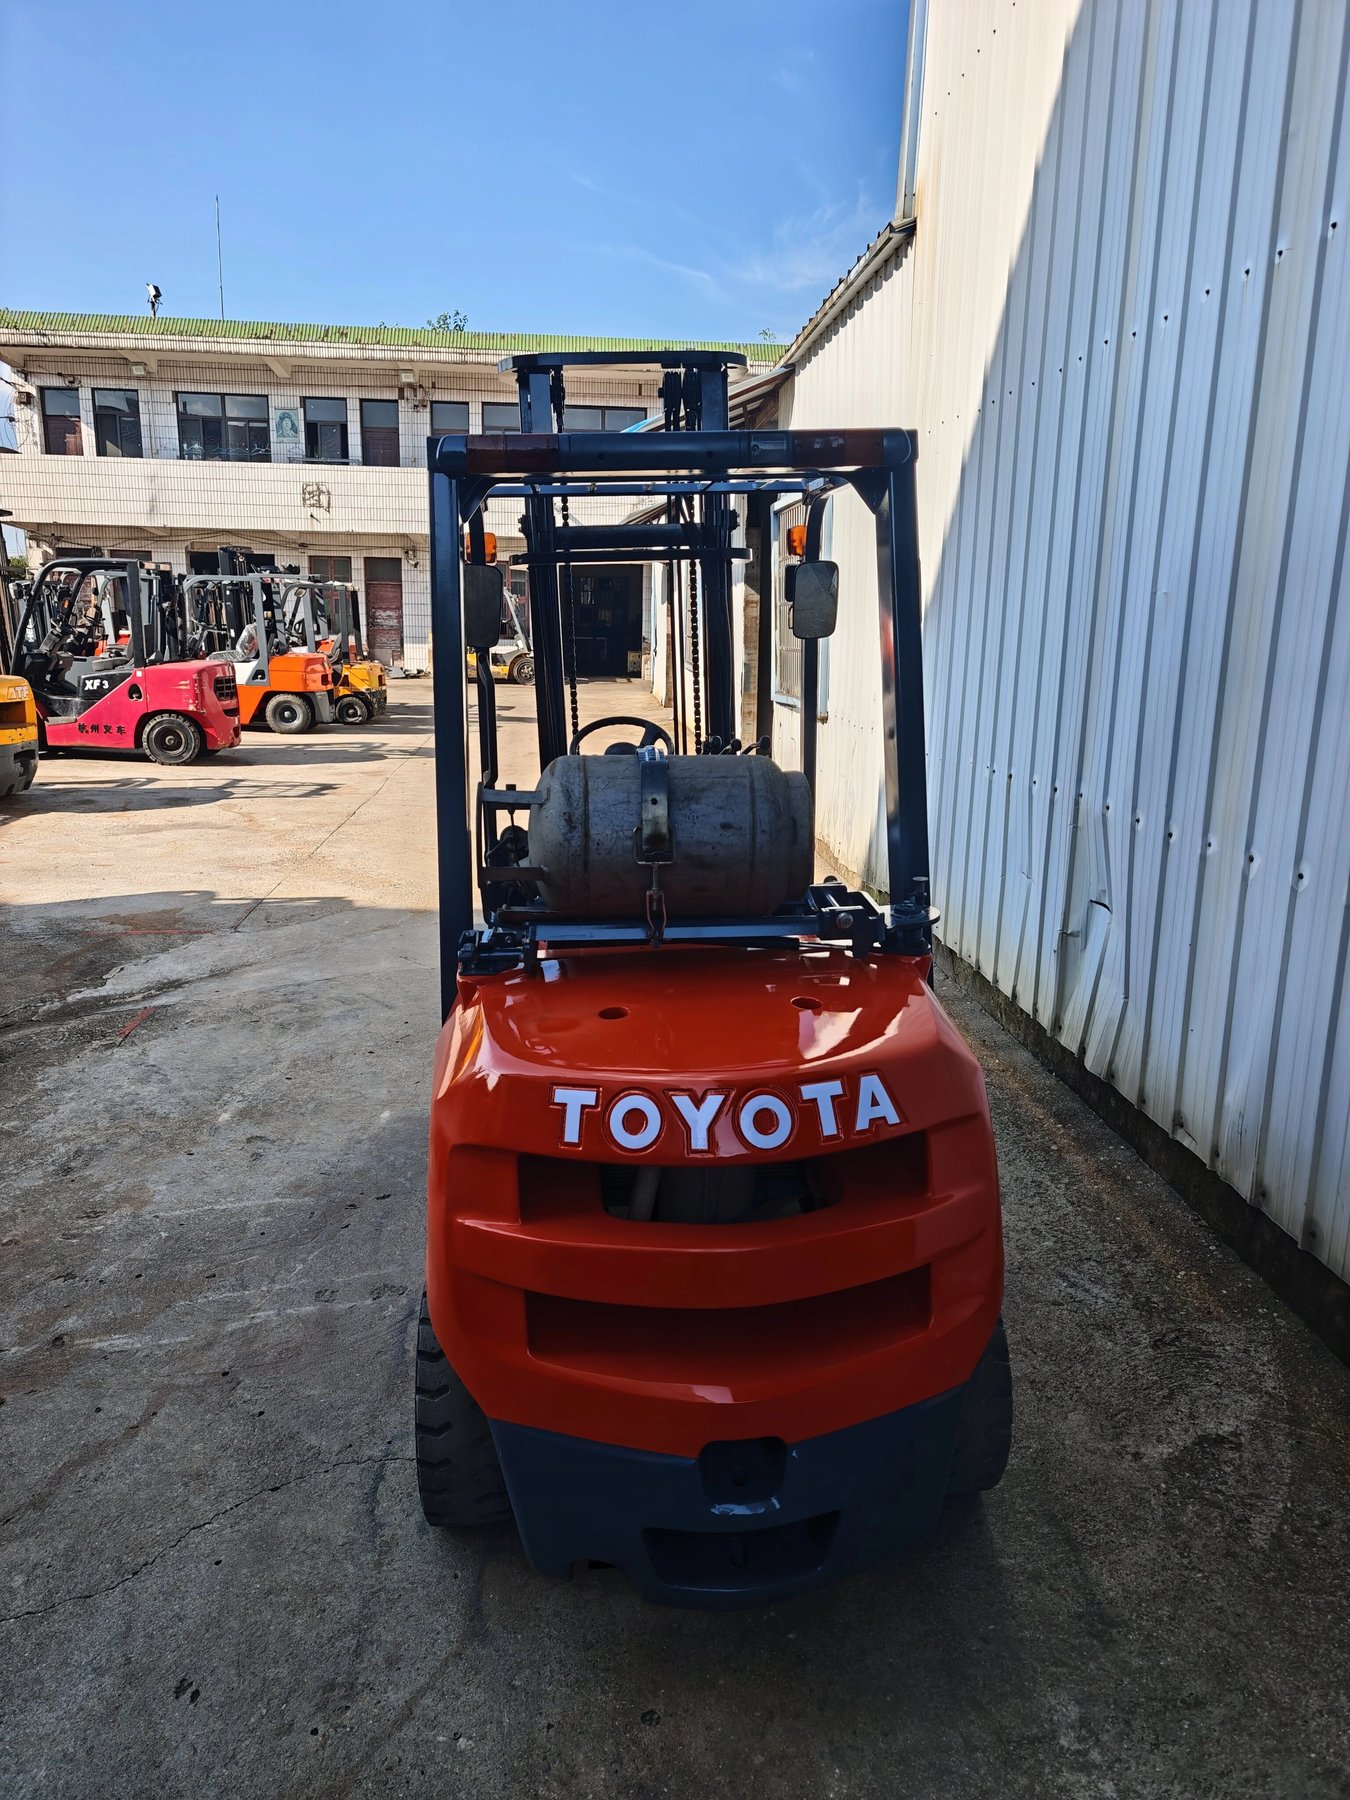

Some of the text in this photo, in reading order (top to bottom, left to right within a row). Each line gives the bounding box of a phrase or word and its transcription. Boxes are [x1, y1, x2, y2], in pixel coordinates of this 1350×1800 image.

[84, 679, 109, 690] XF 3
[78, 722, 126, 735] 杭州叉车
[552, 1073, 902, 1151] TOYOTA
